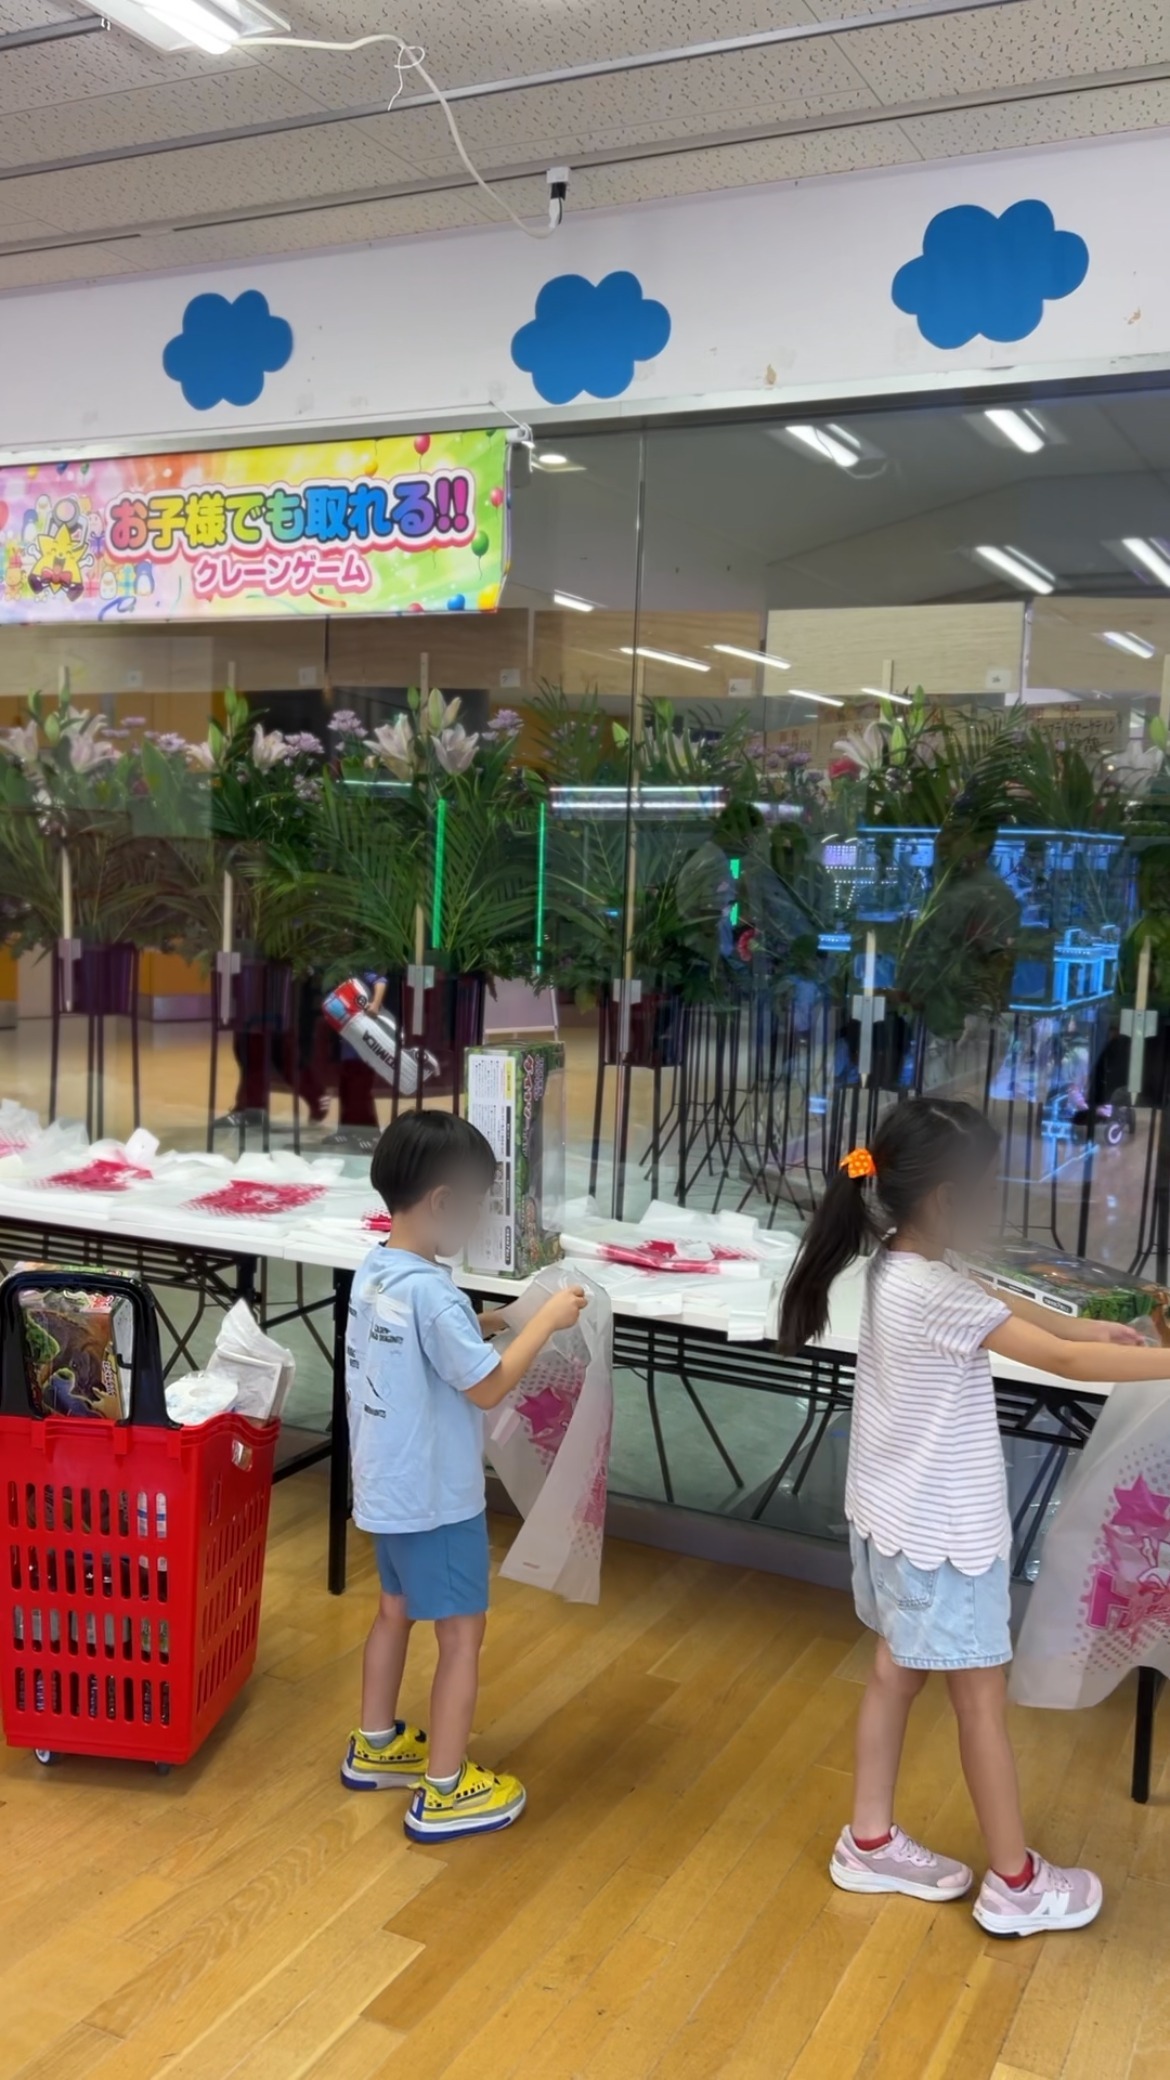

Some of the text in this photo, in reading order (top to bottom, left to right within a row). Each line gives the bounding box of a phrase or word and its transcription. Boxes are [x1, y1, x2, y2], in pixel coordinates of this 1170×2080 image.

[109, 475, 470, 550] お子様でも取れる!!
[196, 553, 366, 588] クレーンゲーム
[362, 1030, 398, 1070] OMICA
